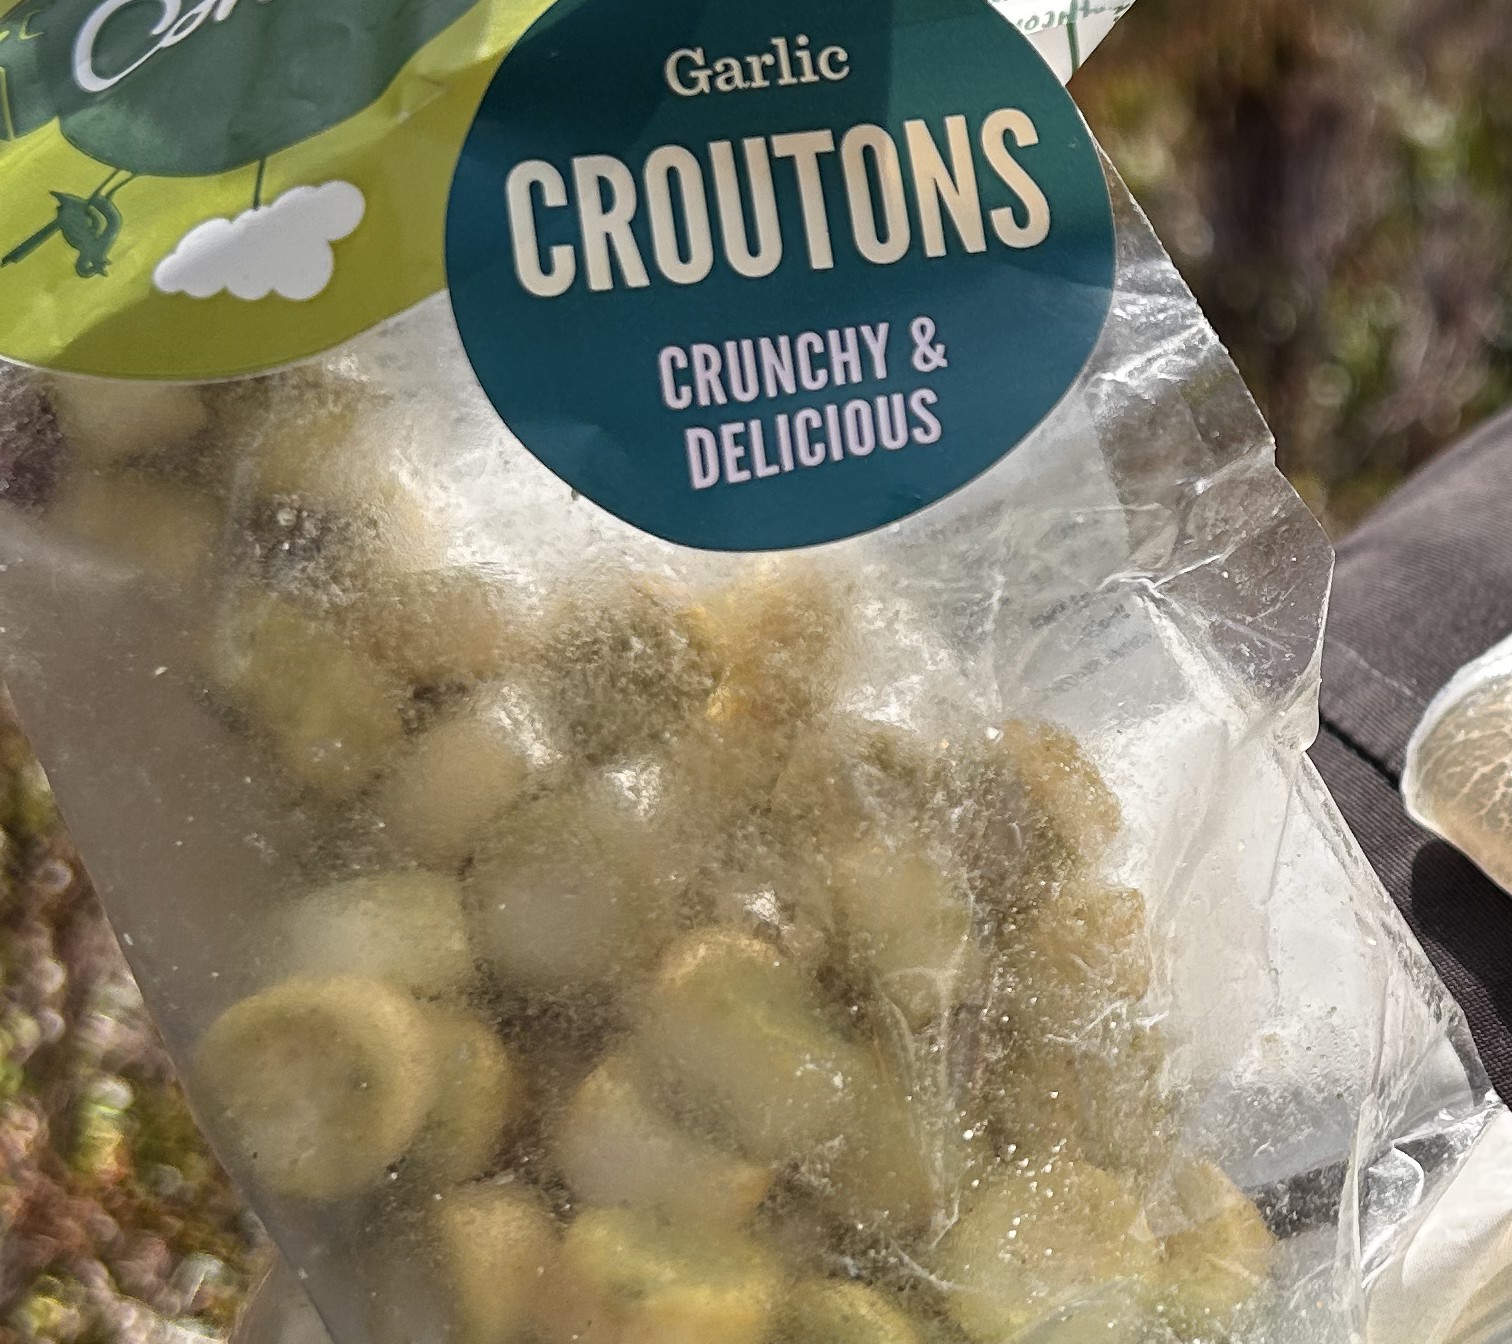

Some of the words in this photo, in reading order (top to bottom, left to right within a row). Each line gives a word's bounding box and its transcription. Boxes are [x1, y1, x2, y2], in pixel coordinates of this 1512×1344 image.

[662, 35, 851, 98] Garlic
[503, 106, 1051, 299] CROUTONS
[657, 319, 889, 412] CRUNCHY
[911, 315, 948, 371] &
[683, 388, 943, 493] DELICIOUS
